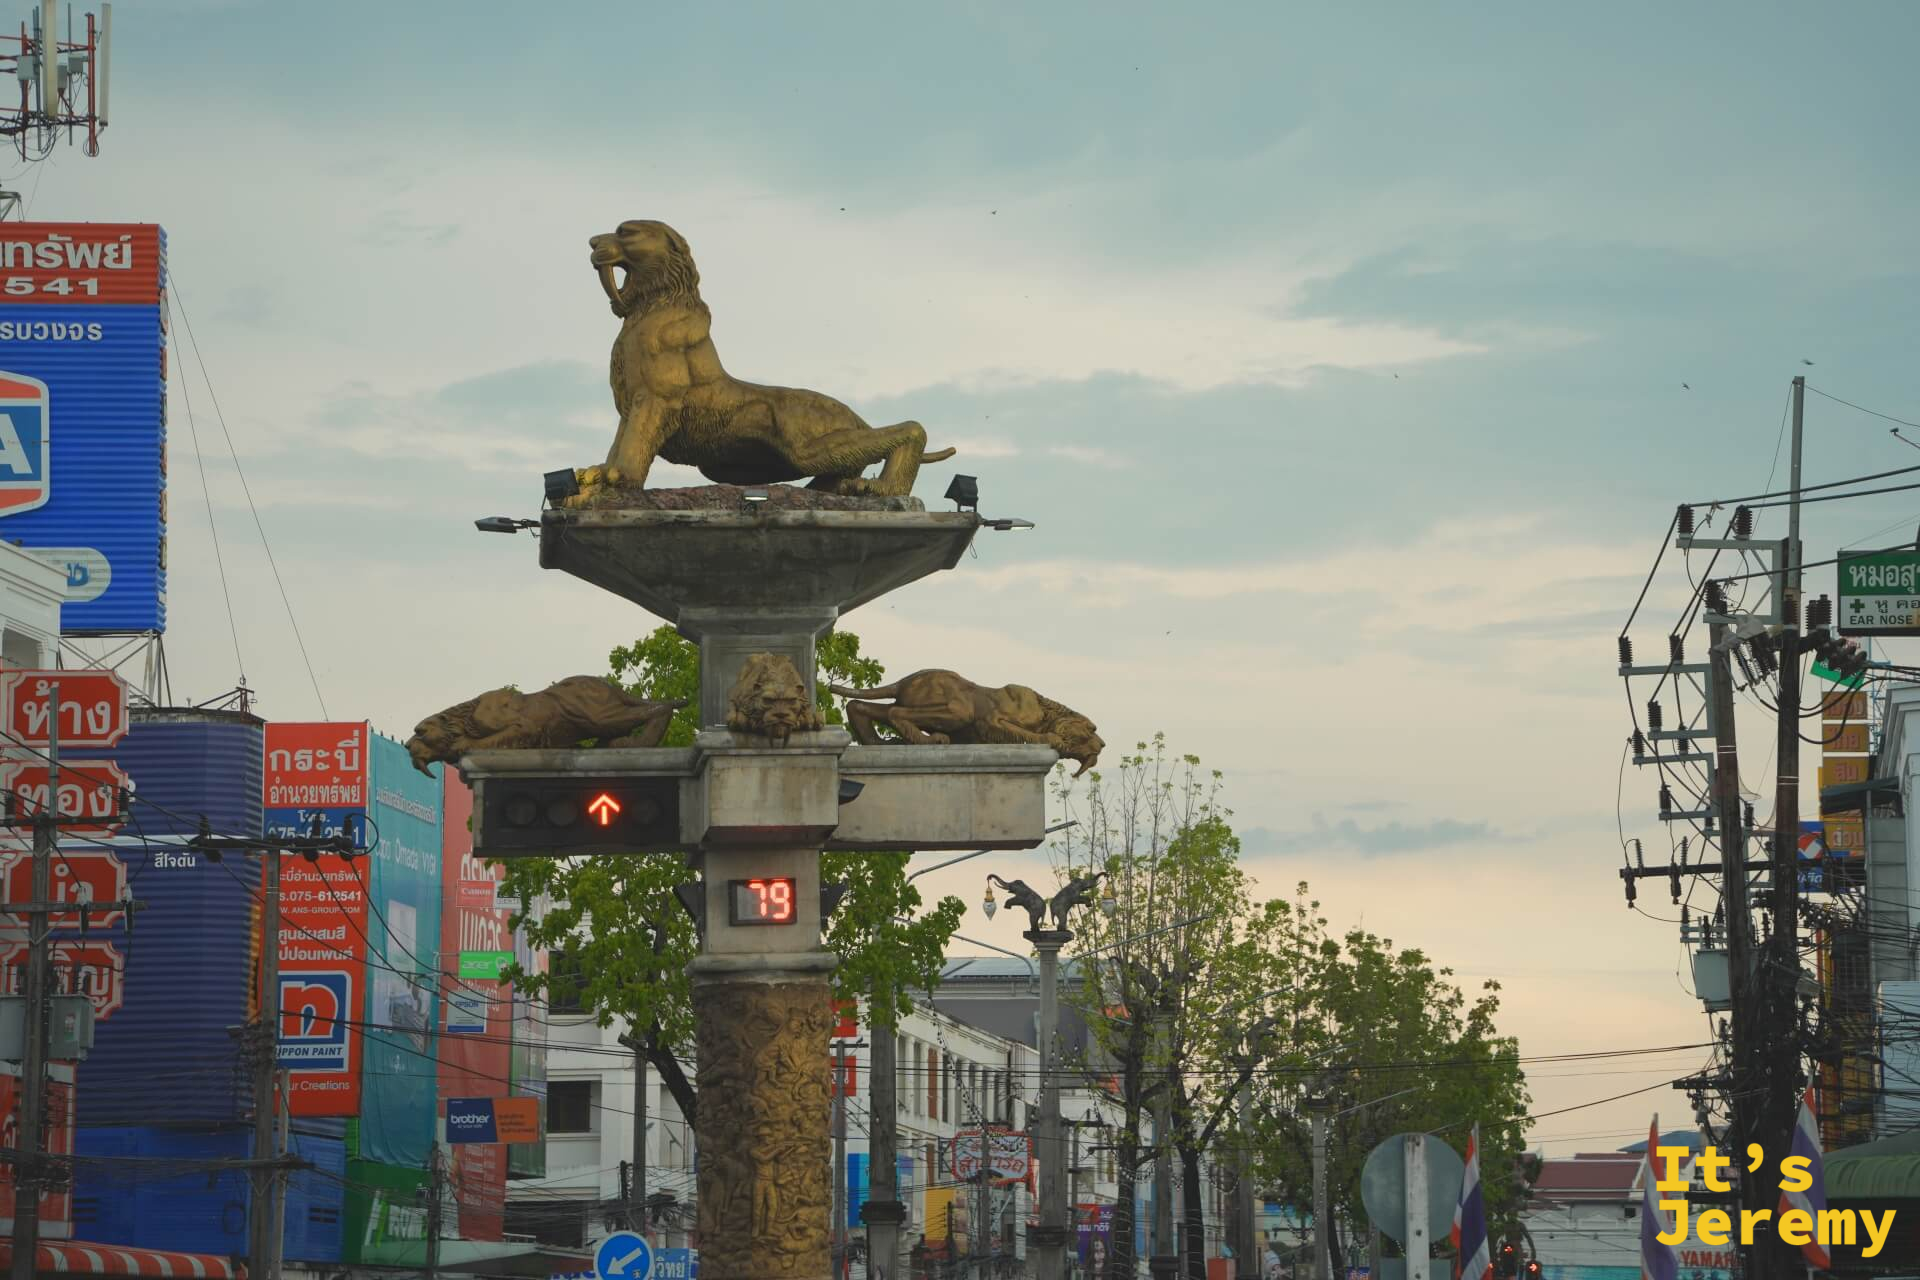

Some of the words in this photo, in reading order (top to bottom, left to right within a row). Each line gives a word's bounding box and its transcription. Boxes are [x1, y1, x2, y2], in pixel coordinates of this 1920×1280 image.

[0, 233, 132, 269] ทรัพย์
[1849, 564, 1920, 594] หมอสุ
[1850, 615, 1874, 625] EAR
[1880, 615, 1913, 625] NOSE
[22, 679, 111, 735] ห้าง
[269, 729, 360, 772] กระบี่
[270, 776, 361, 804] อำนวยทรัพย์
[749, 882, 790, 920] 79
[312, 1047, 343, 1057] PAINT
[300, 1080, 351, 1091] Creations
[450, 1114, 491, 1125] brother
